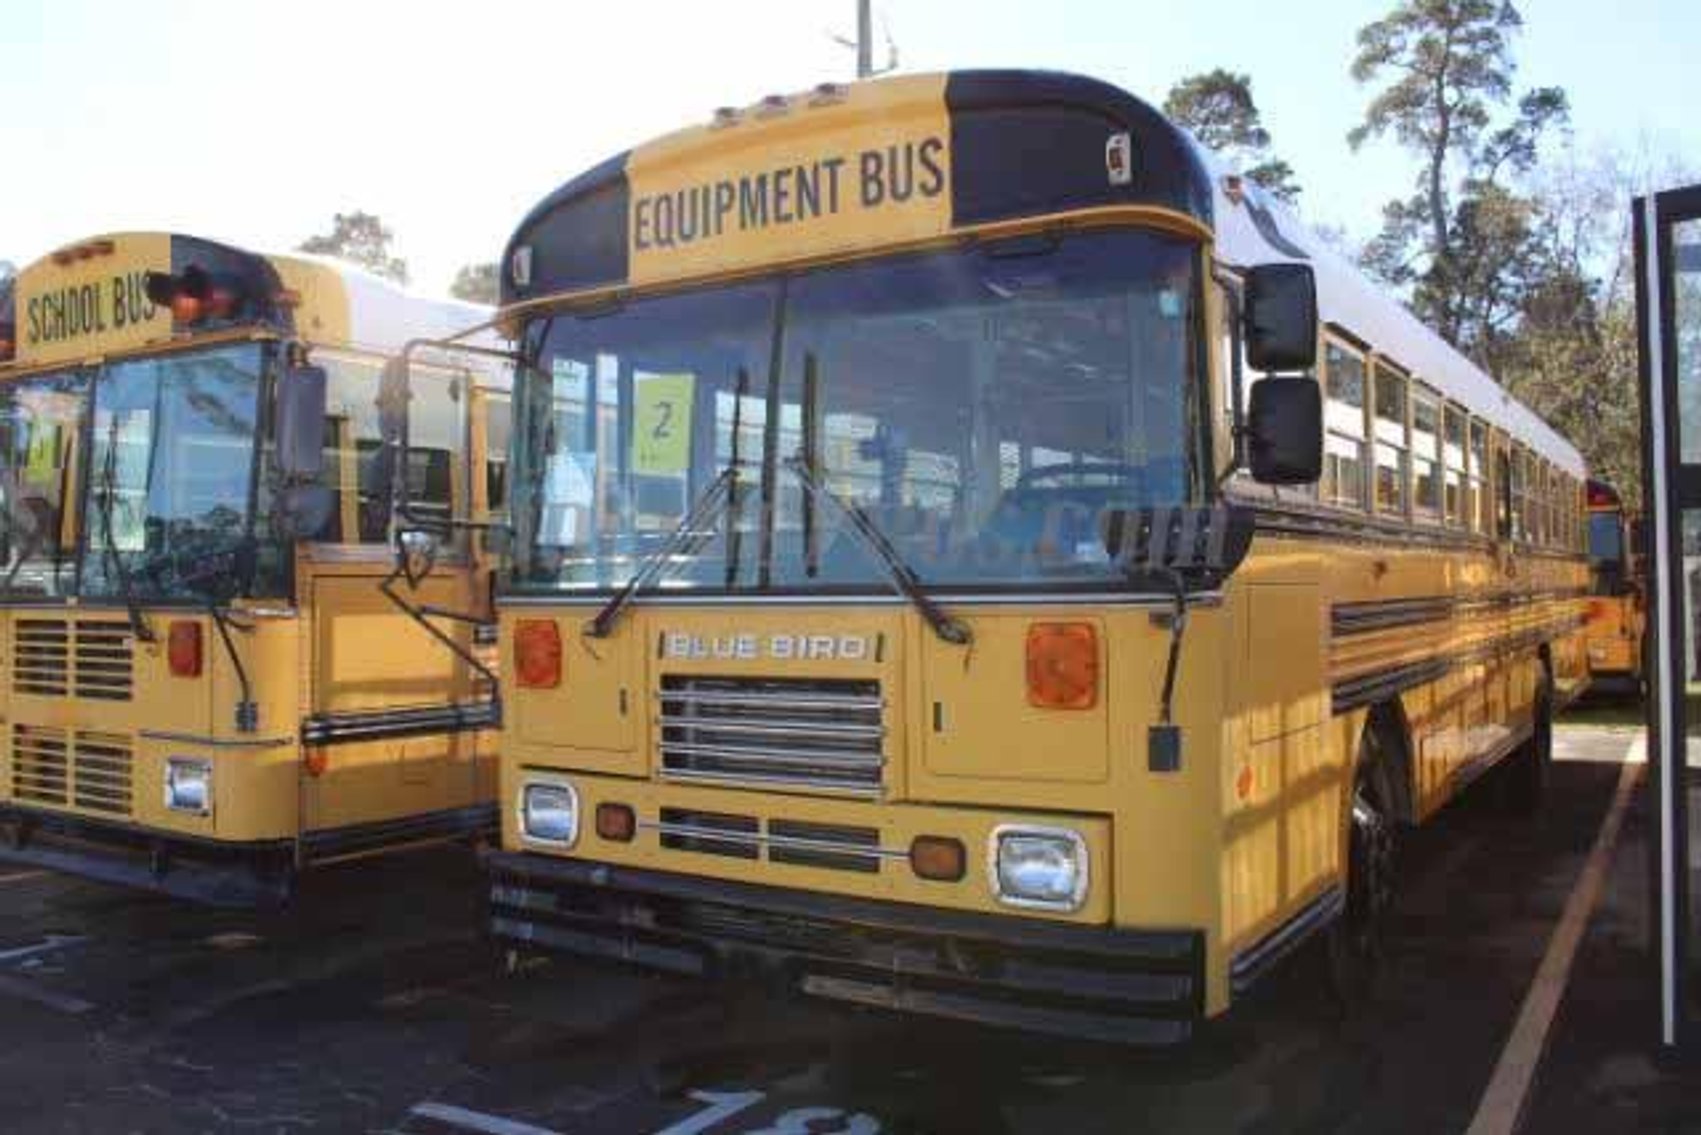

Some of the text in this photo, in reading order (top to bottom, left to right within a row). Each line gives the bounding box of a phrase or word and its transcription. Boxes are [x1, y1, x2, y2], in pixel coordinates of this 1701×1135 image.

[634, 137, 945, 250] EQUIPMENT BUS
[28, 268, 156, 344] SCHOOL BUS
[652, 400, 672, 440] 2
[666, 633, 867, 660] BLUE BIRD
